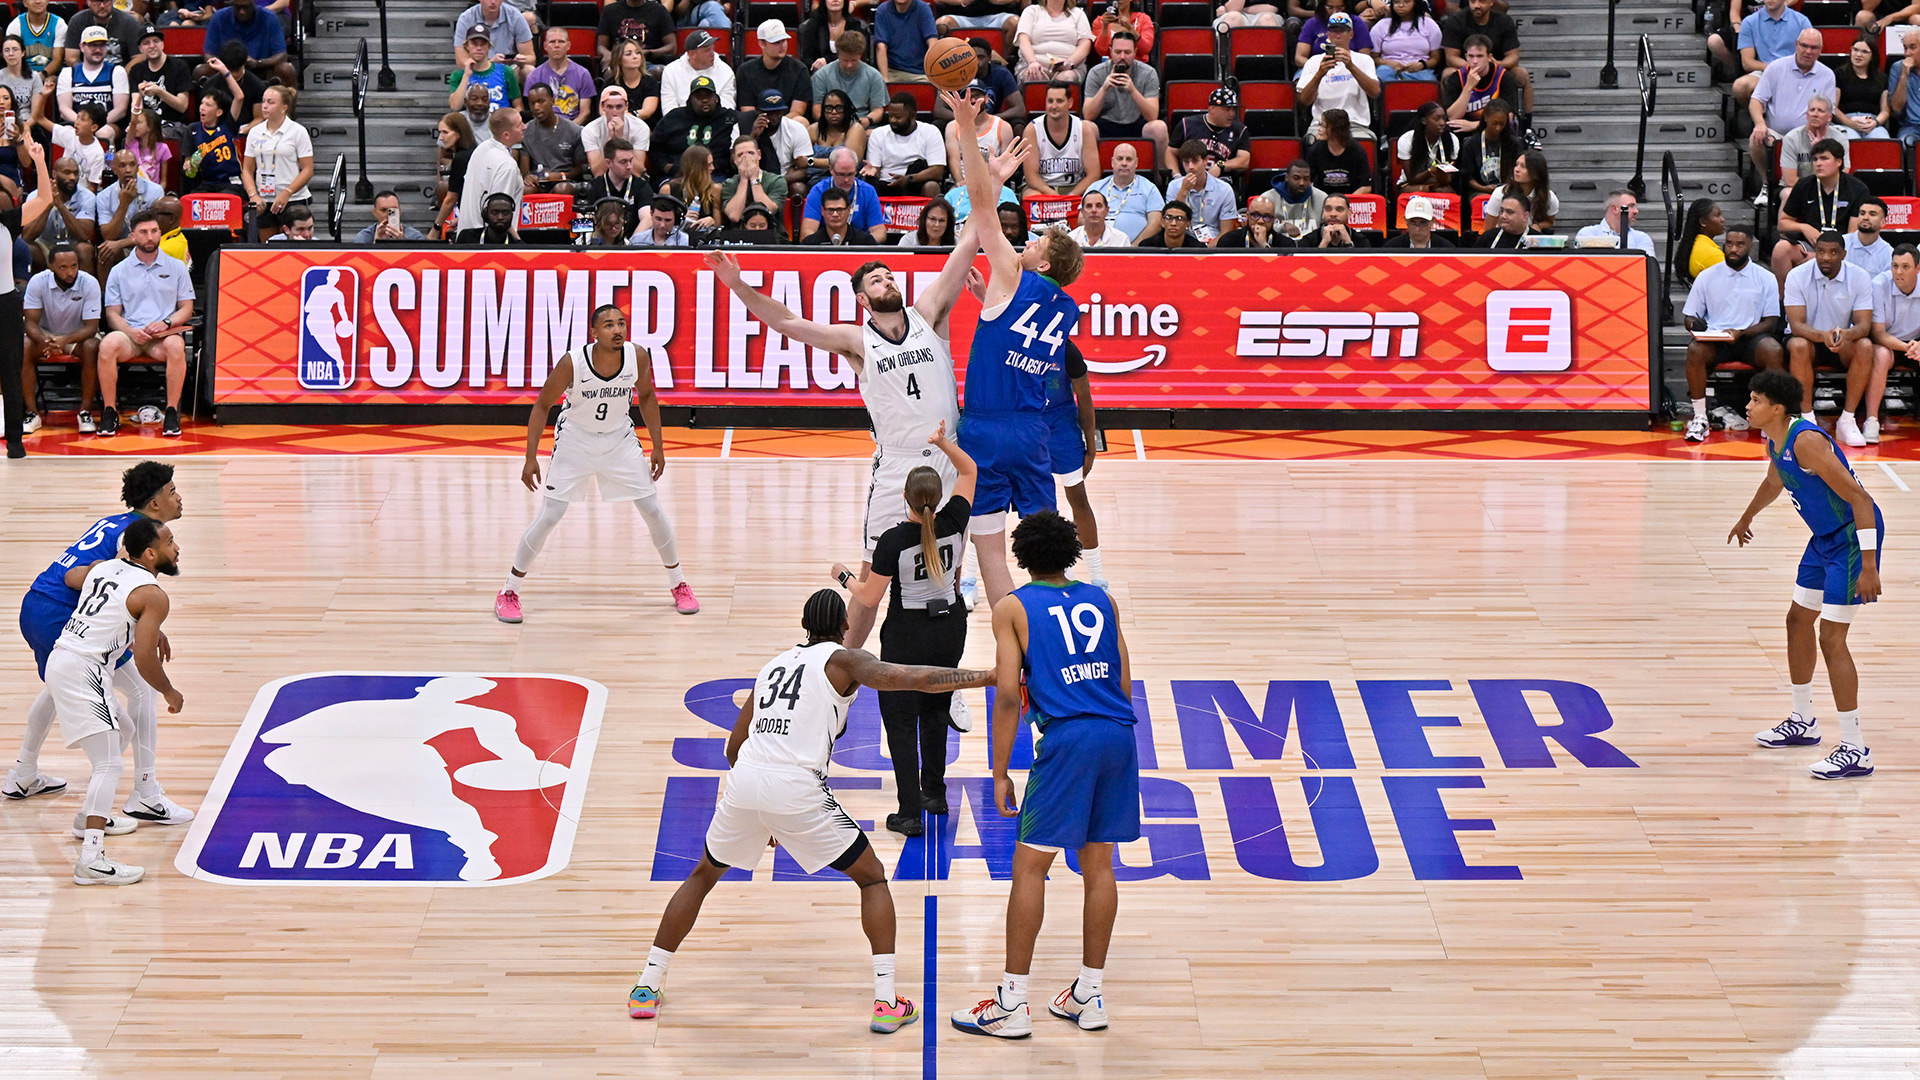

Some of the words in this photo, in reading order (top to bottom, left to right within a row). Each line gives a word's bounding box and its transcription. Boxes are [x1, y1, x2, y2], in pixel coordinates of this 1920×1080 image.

[326, 21, 344, 32] FF
[1664, 18, 1684, 29] FF
[939, 51, 973, 70] Wilson
[313, 73, 333, 84] EE
[1677, 72, 1696, 83] EE
[1695, 127, 1717, 139] DD
[214, 146, 232, 162] 30
[1708, 183, 1731, 195] CC
[203, 200, 230, 211] SUMMER
[534, 202, 565, 213] SUMMER
[1043, 201, 1072, 212] SUMMER
[203, 210, 226, 221] LEAGUE
[534, 213, 560, 224] LEAGUE
[1009, 302, 1065, 356] 44
[1236, 311, 1420, 357] ESPN
[1505, 308, 1552, 353] E
[876, 356, 897, 374] NEW
[897, 347, 934, 367] ORLEANS
[307, 361, 334, 380] NBA
[581, 389, 598, 399] NEW
[907, 372, 921, 400] 4
[595, 403, 608, 421] 9
[78, 577, 119, 617] 15
[1048, 602, 1104, 655] 19
[759, 664, 806, 710] 34
[753, 717, 791, 735] MOORE
[238, 832, 414, 869] NBA
